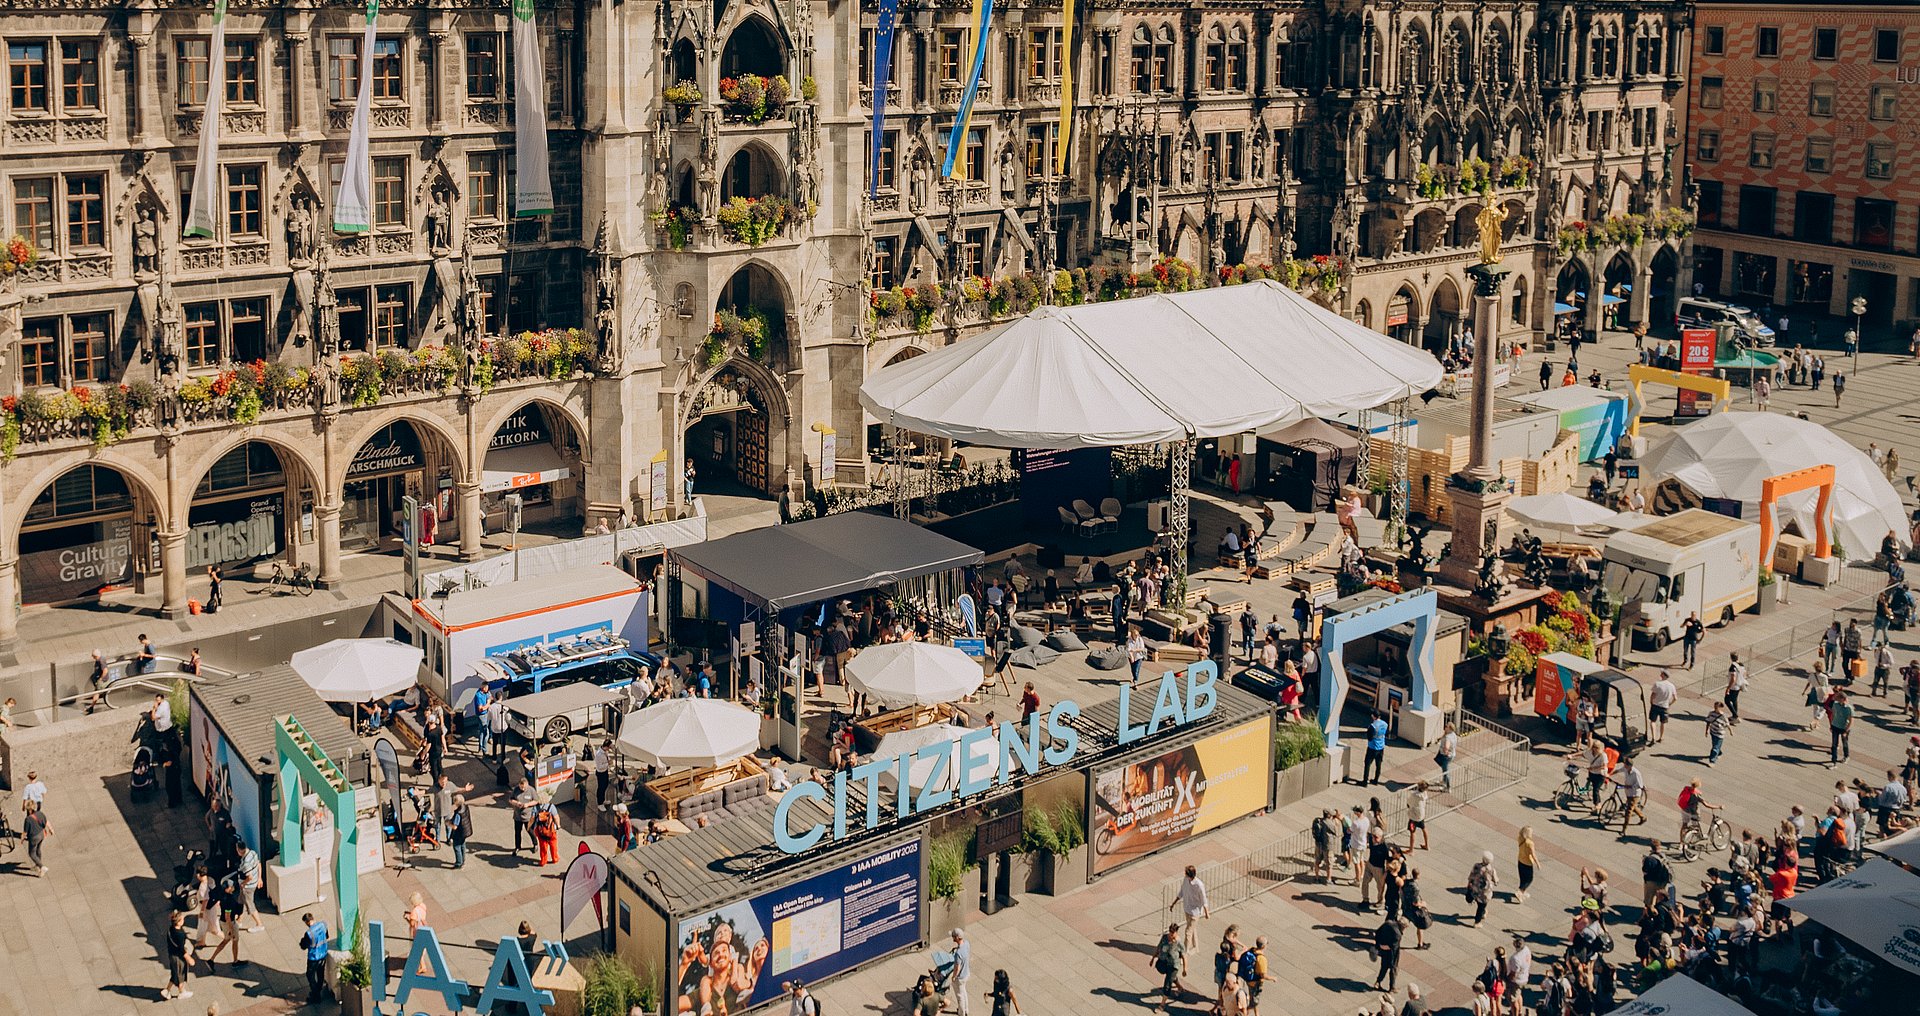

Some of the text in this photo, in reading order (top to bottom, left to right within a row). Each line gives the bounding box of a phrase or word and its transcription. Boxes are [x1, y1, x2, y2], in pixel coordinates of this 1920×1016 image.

[1895, 67, 1920, 83] LU
[1688, 346, 1701, 357] 20
[506, 415, 527, 430] TIK
[491, 430, 540, 447] RTKORN
[346, 454, 415, 474] ARSCHMUCK
[1626, 469, 1637, 478] 14
[403, 502, 410, 520] S
[184, 515, 276, 569] BERGSON
[404, 523, 412, 543] U
[59, 540, 132, 567] Cultural
[59, 559, 128, 582] Gravity
[773, 659, 1219, 855] CITIZENS LAB
[1131, 784, 1175, 812] MOBILITÄT
[1116, 811, 1135, 828] DER
[1135, 797, 1175, 821] ZUKUNFT
[583, 863, 597, 879] M
[857, 860, 871, 873] IAA
